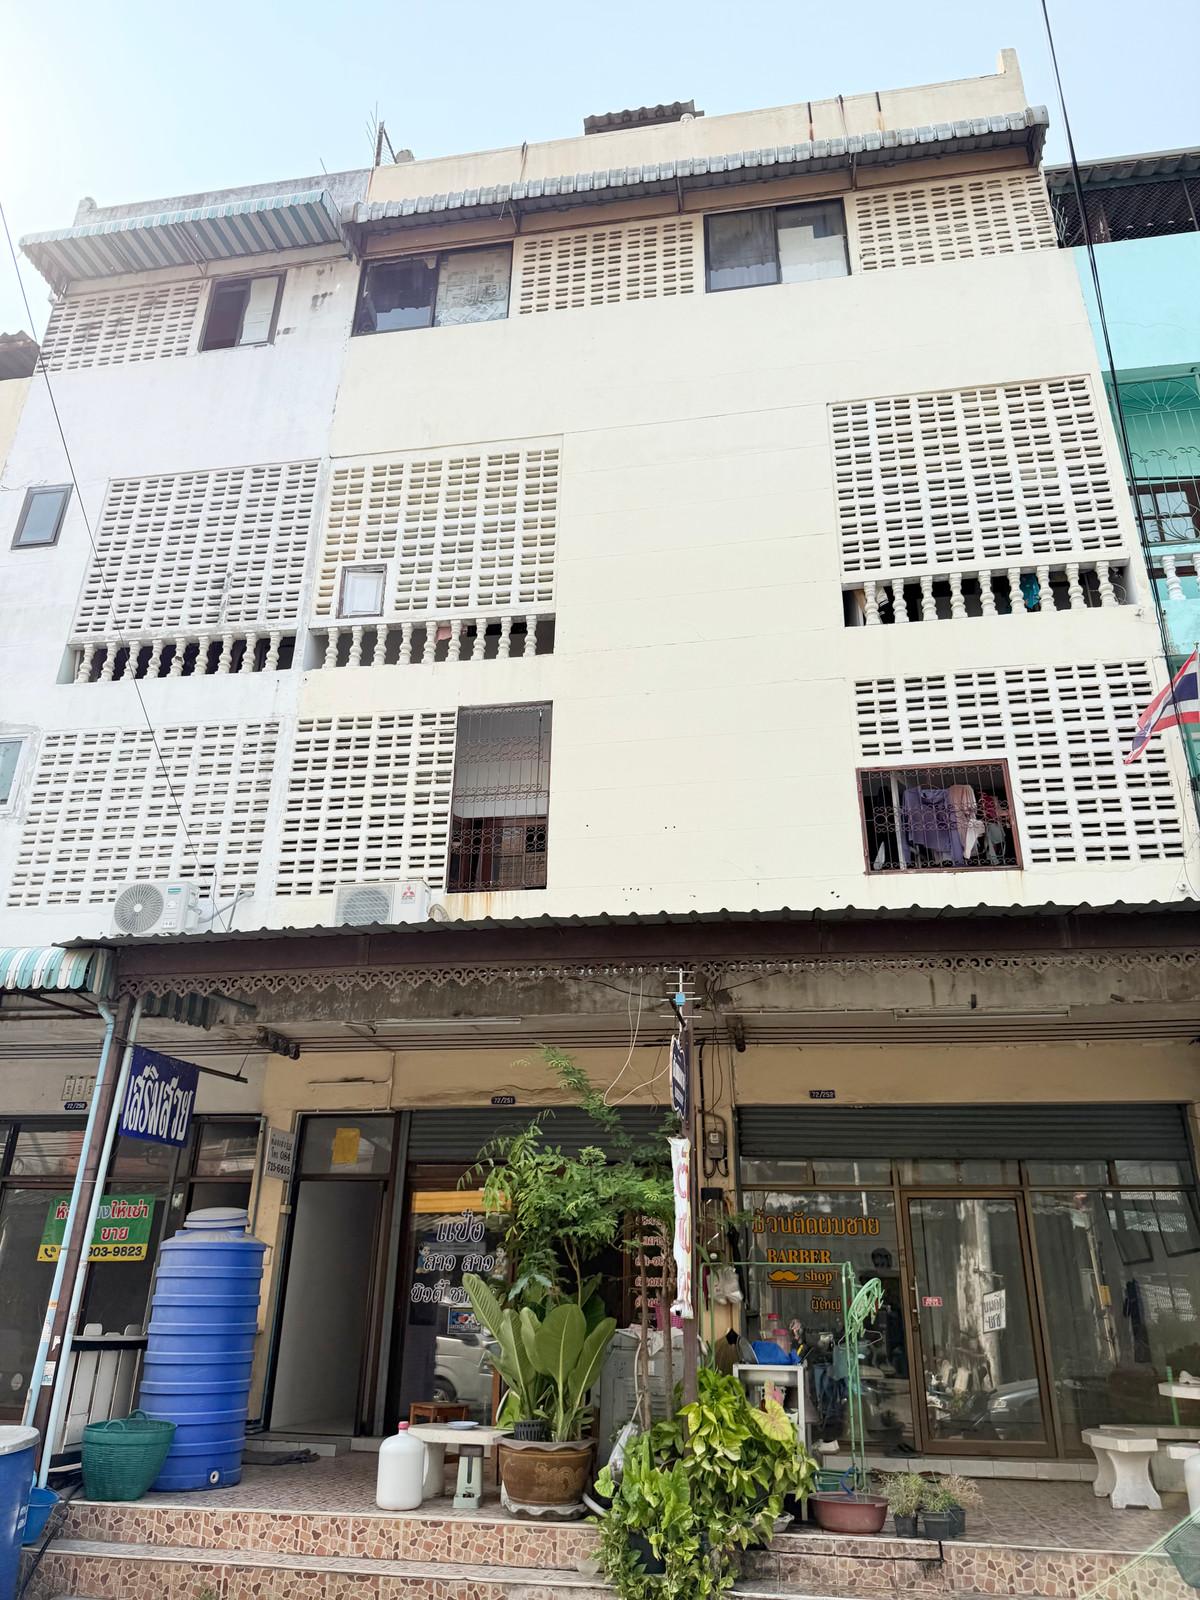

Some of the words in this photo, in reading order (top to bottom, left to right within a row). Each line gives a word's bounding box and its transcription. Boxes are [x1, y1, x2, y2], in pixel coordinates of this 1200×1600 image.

[123, 1064, 194, 1141] เสริมสวย
[101, 1226, 129, 1241] ขาย
[461, 1253, 495, 1272] สาว
[766, 1248, 831, 1264] BARBER
[804, 1268, 833, 1285] shop
